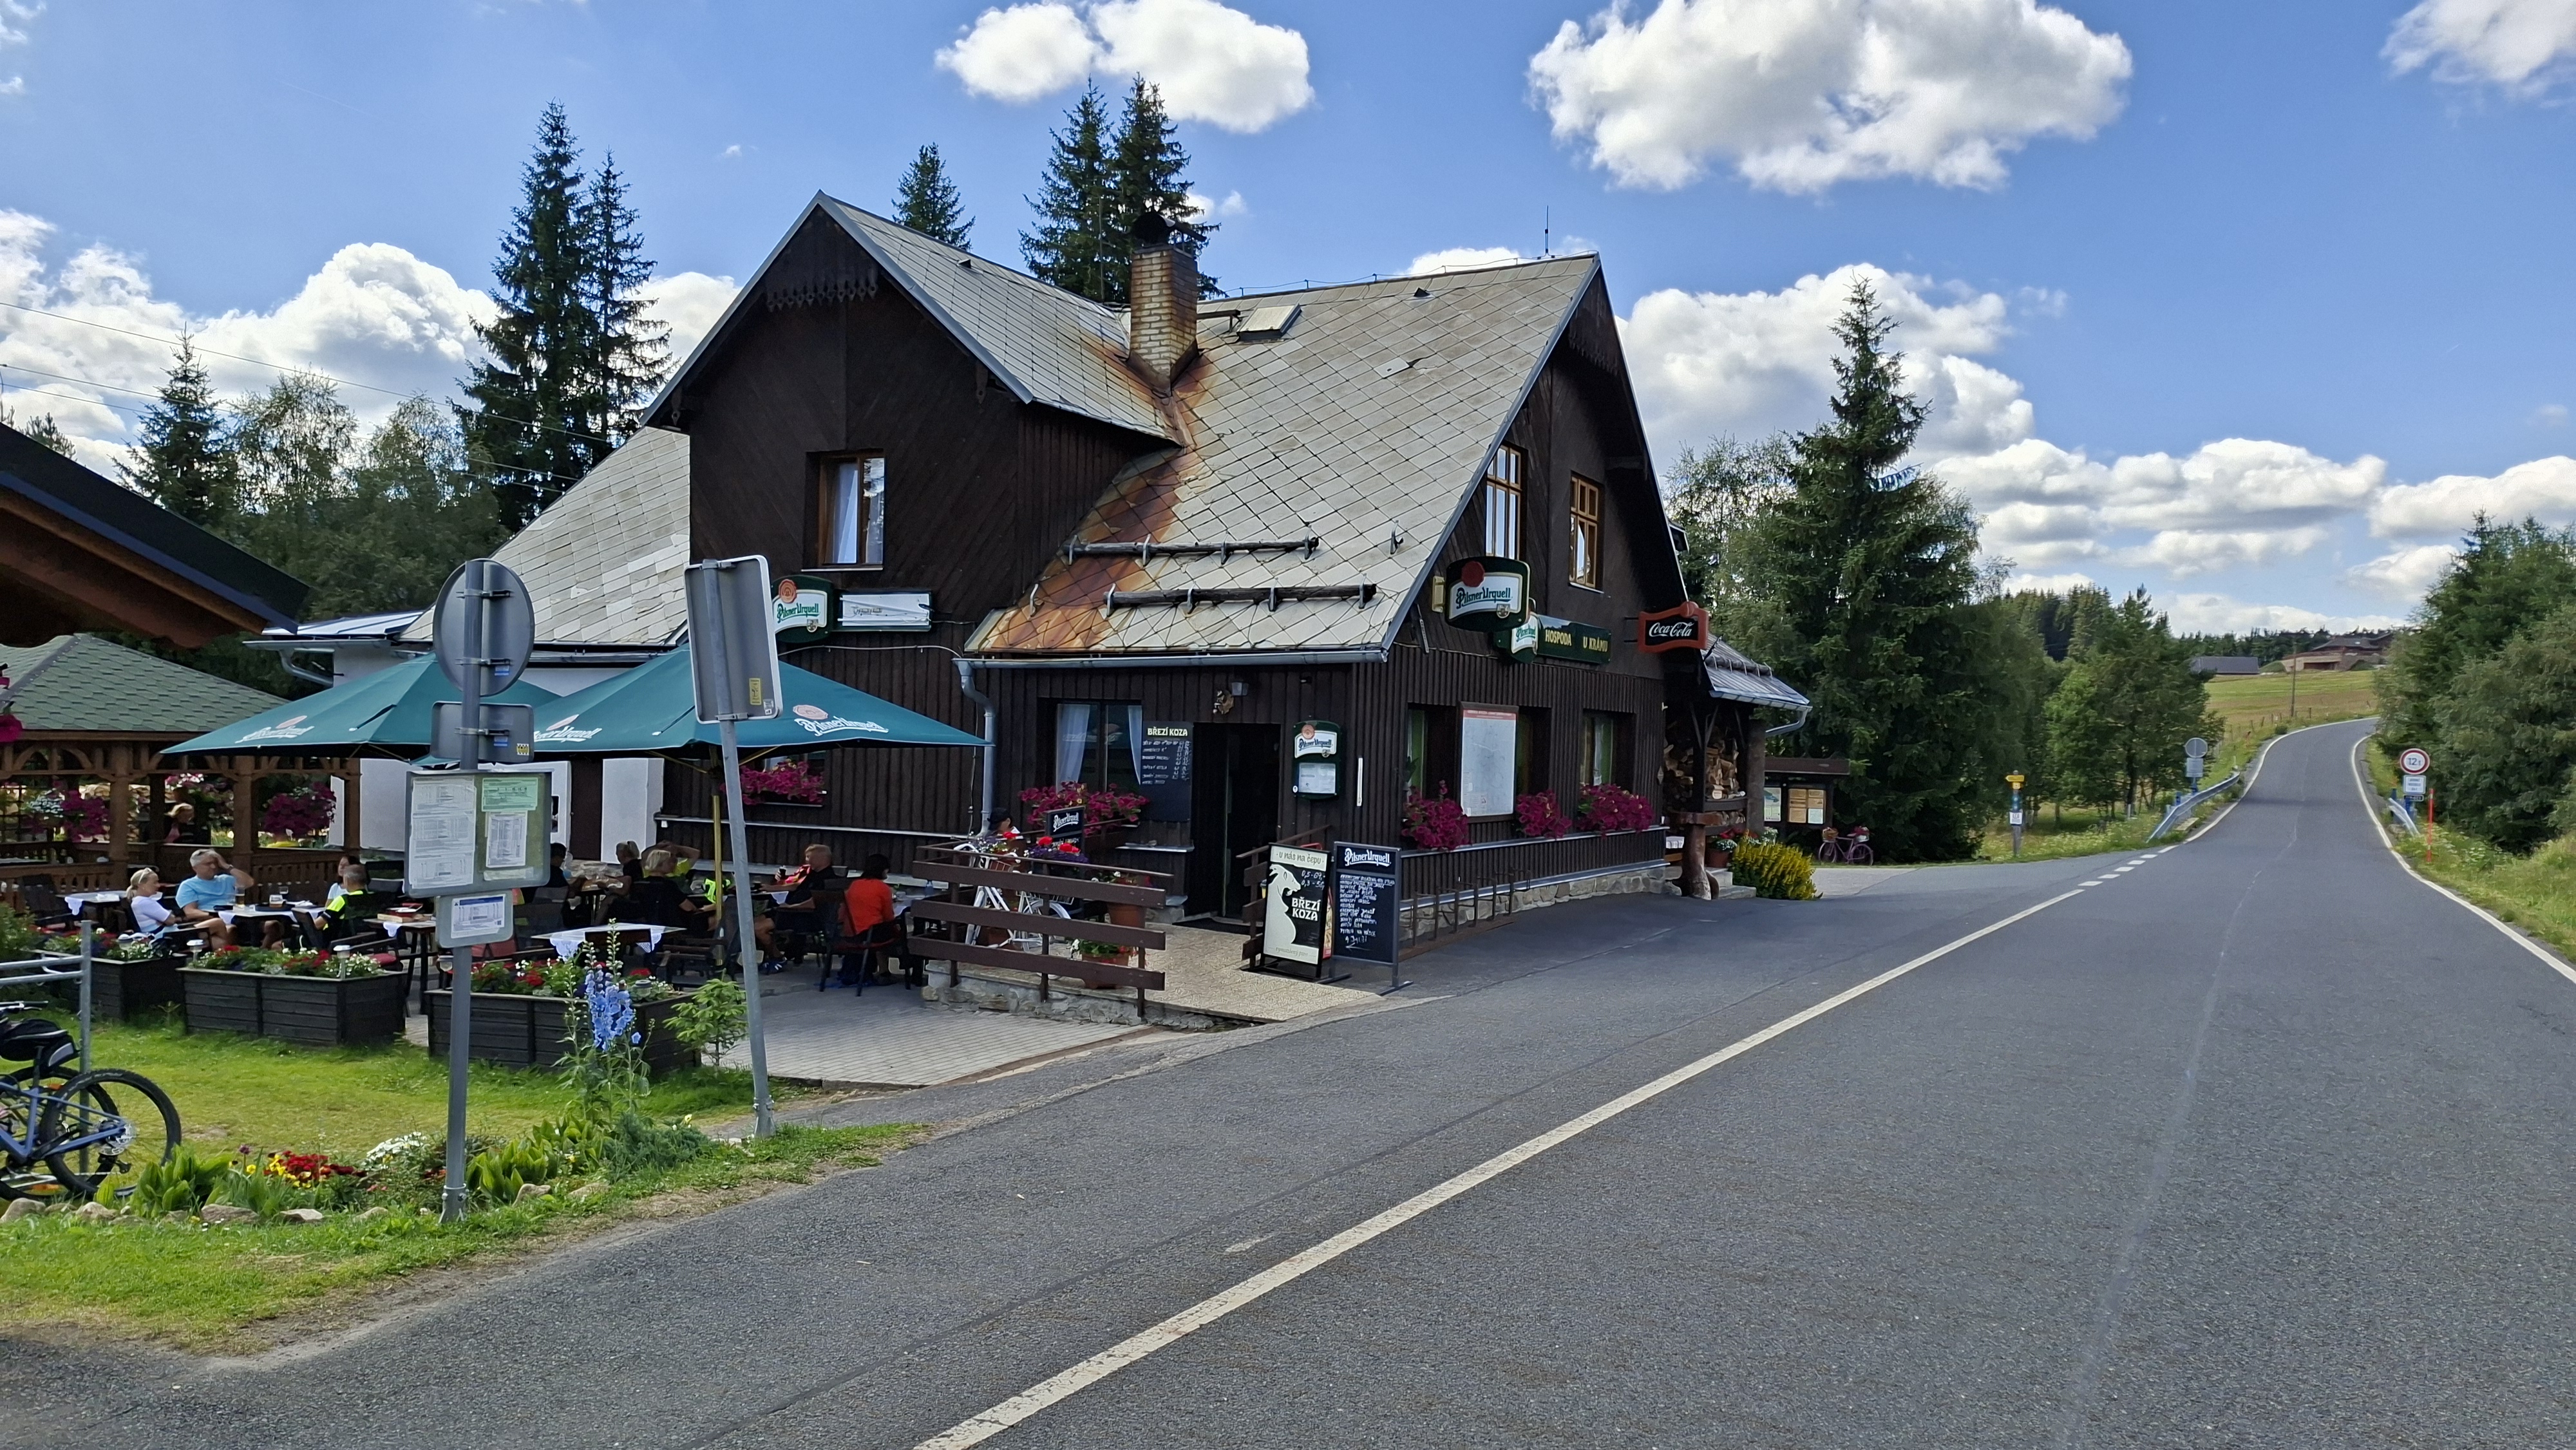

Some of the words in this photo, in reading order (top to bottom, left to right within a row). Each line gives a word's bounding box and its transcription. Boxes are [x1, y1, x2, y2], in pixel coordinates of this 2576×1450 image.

[1456, 587, 1482, 610] Pilsner
[1482, 587, 1511, 603] Urquell
[777, 603, 797, 623] Pilsner
[797, 602, 819, 617] Urquell
[1649, 621, 1694, 637] Coca-Cola
[1545, 629, 1572, 646] HOSPODA
[1583, 636, 1587, 648] U
[794, 717, 844, 737] Pilsner
[1147, 726, 1169, 736] BŘEZÍ
[1169, 728, 1188, 737] KOZA
[1298, 738, 1314, 751] Pilsner
[1314, 738, 1332, 748] Urquell
[1284, 851, 1296, 861] nás
[1307, 854, 1321, 865] čepu
[1344, 847, 1367, 867] Pilsner
[1366, 849, 1390, 867] Urquell
[1291, 896, 1321, 912] BŘEZÍ
[1292, 907, 1318, 921] KOZA
